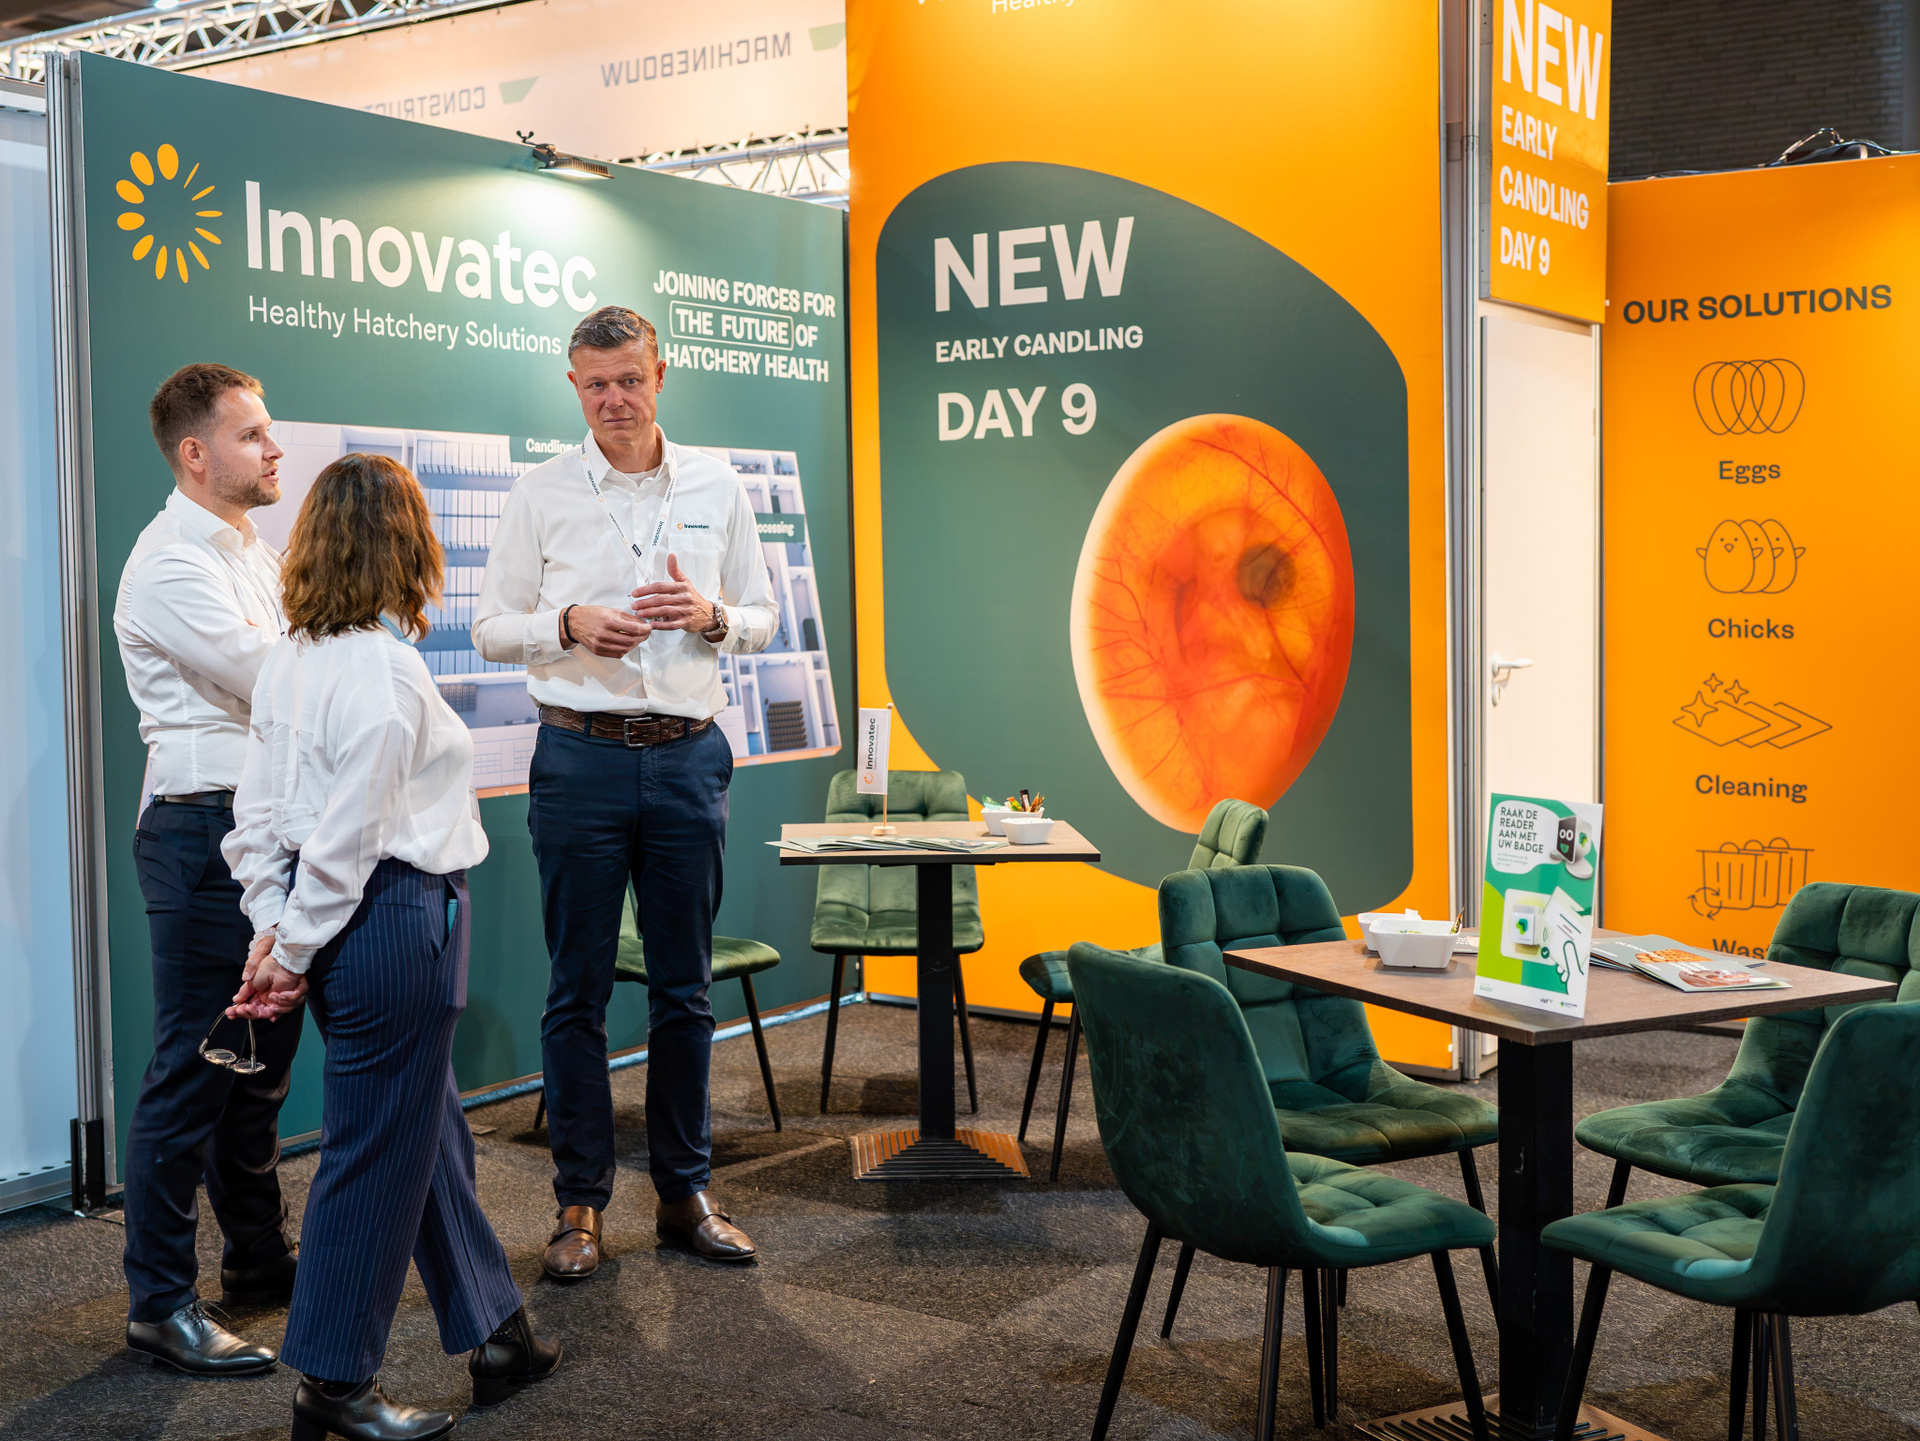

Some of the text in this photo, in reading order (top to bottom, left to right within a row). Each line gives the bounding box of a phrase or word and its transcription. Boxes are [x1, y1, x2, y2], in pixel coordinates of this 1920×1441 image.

[1502, 0, 1604, 121] NEW
[1501, 104, 1558, 161] EARLY
[1500, 165, 1589, 230] CANDLING
[245, 180, 598, 313] Innovatec
[934, 216, 1135, 312] NEW
[1500, 226, 1551, 276] DAY 9
[653, 269, 837, 318] JOINING FORCES FOR
[1622, 284, 1893, 325] OUR SOLUTIONS
[249, 295, 562, 355] Healthy Hatchery Solutions
[675, 308, 819, 348] THE FUTURE OF
[935, 325, 1144, 363] EARLY CANDLING
[665, 342, 829, 383] HATCHERY HEALTH
[937, 383, 1098, 442] DAY 9
[1719, 460, 1781, 485] Eggs
[1708, 618, 1795, 640] Chicks
[865, 717, 877, 770] Innovatec
[1695, 774, 1808, 804] Cleaning
[1500, 818, 1534, 830] READER
[1501, 807, 1538, 820] RAAK DE
[1498, 839, 1544, 854] UW BADGE
[1499, 829, 1537, 842] AAN MET
[1712, 938, 1770, 960] Was
